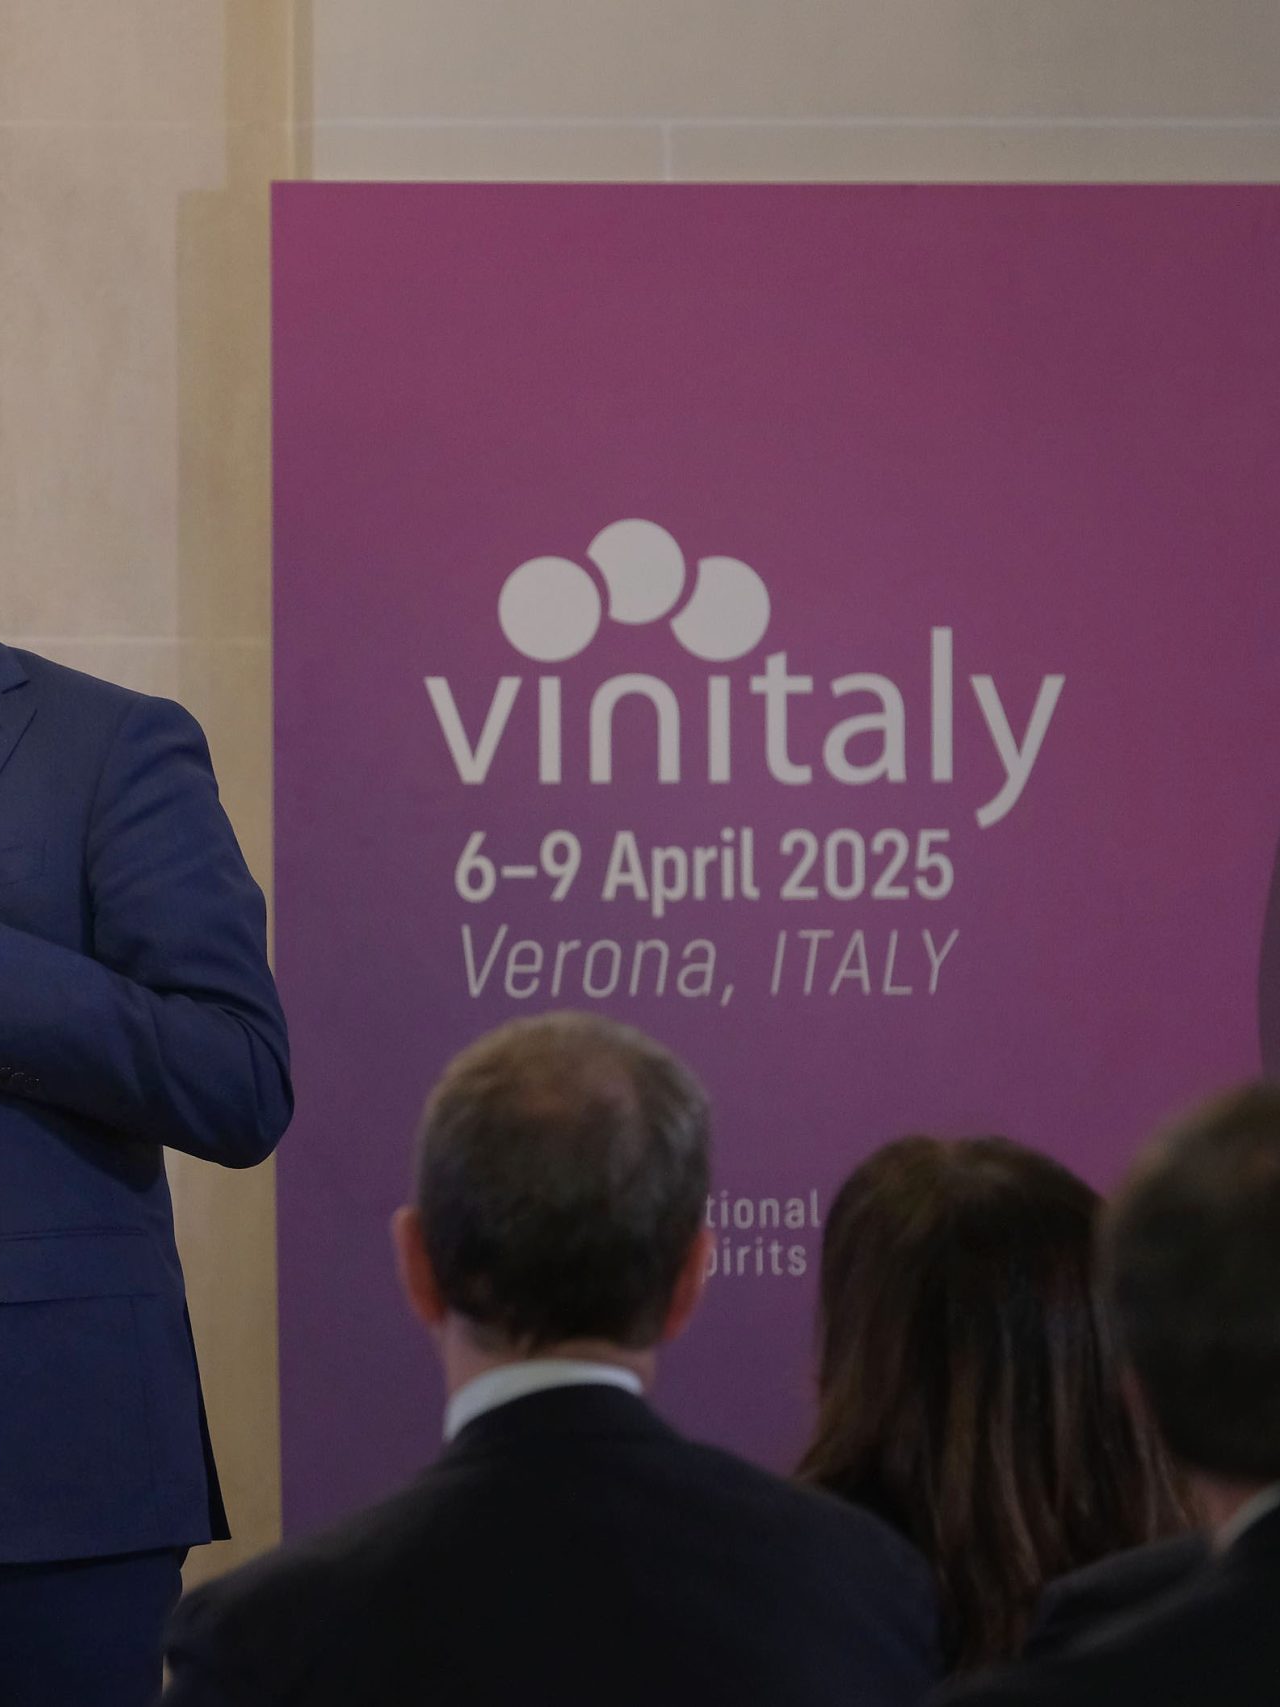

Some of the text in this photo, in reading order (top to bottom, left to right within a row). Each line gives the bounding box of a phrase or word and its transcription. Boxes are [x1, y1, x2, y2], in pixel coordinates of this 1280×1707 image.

[424, 626, 1066, 829] vinitaly
[601, 828, 760, 918] April
[779, 829, 955, 900] 2025
[460, 924, 960, 1006] Verona, ITALY
